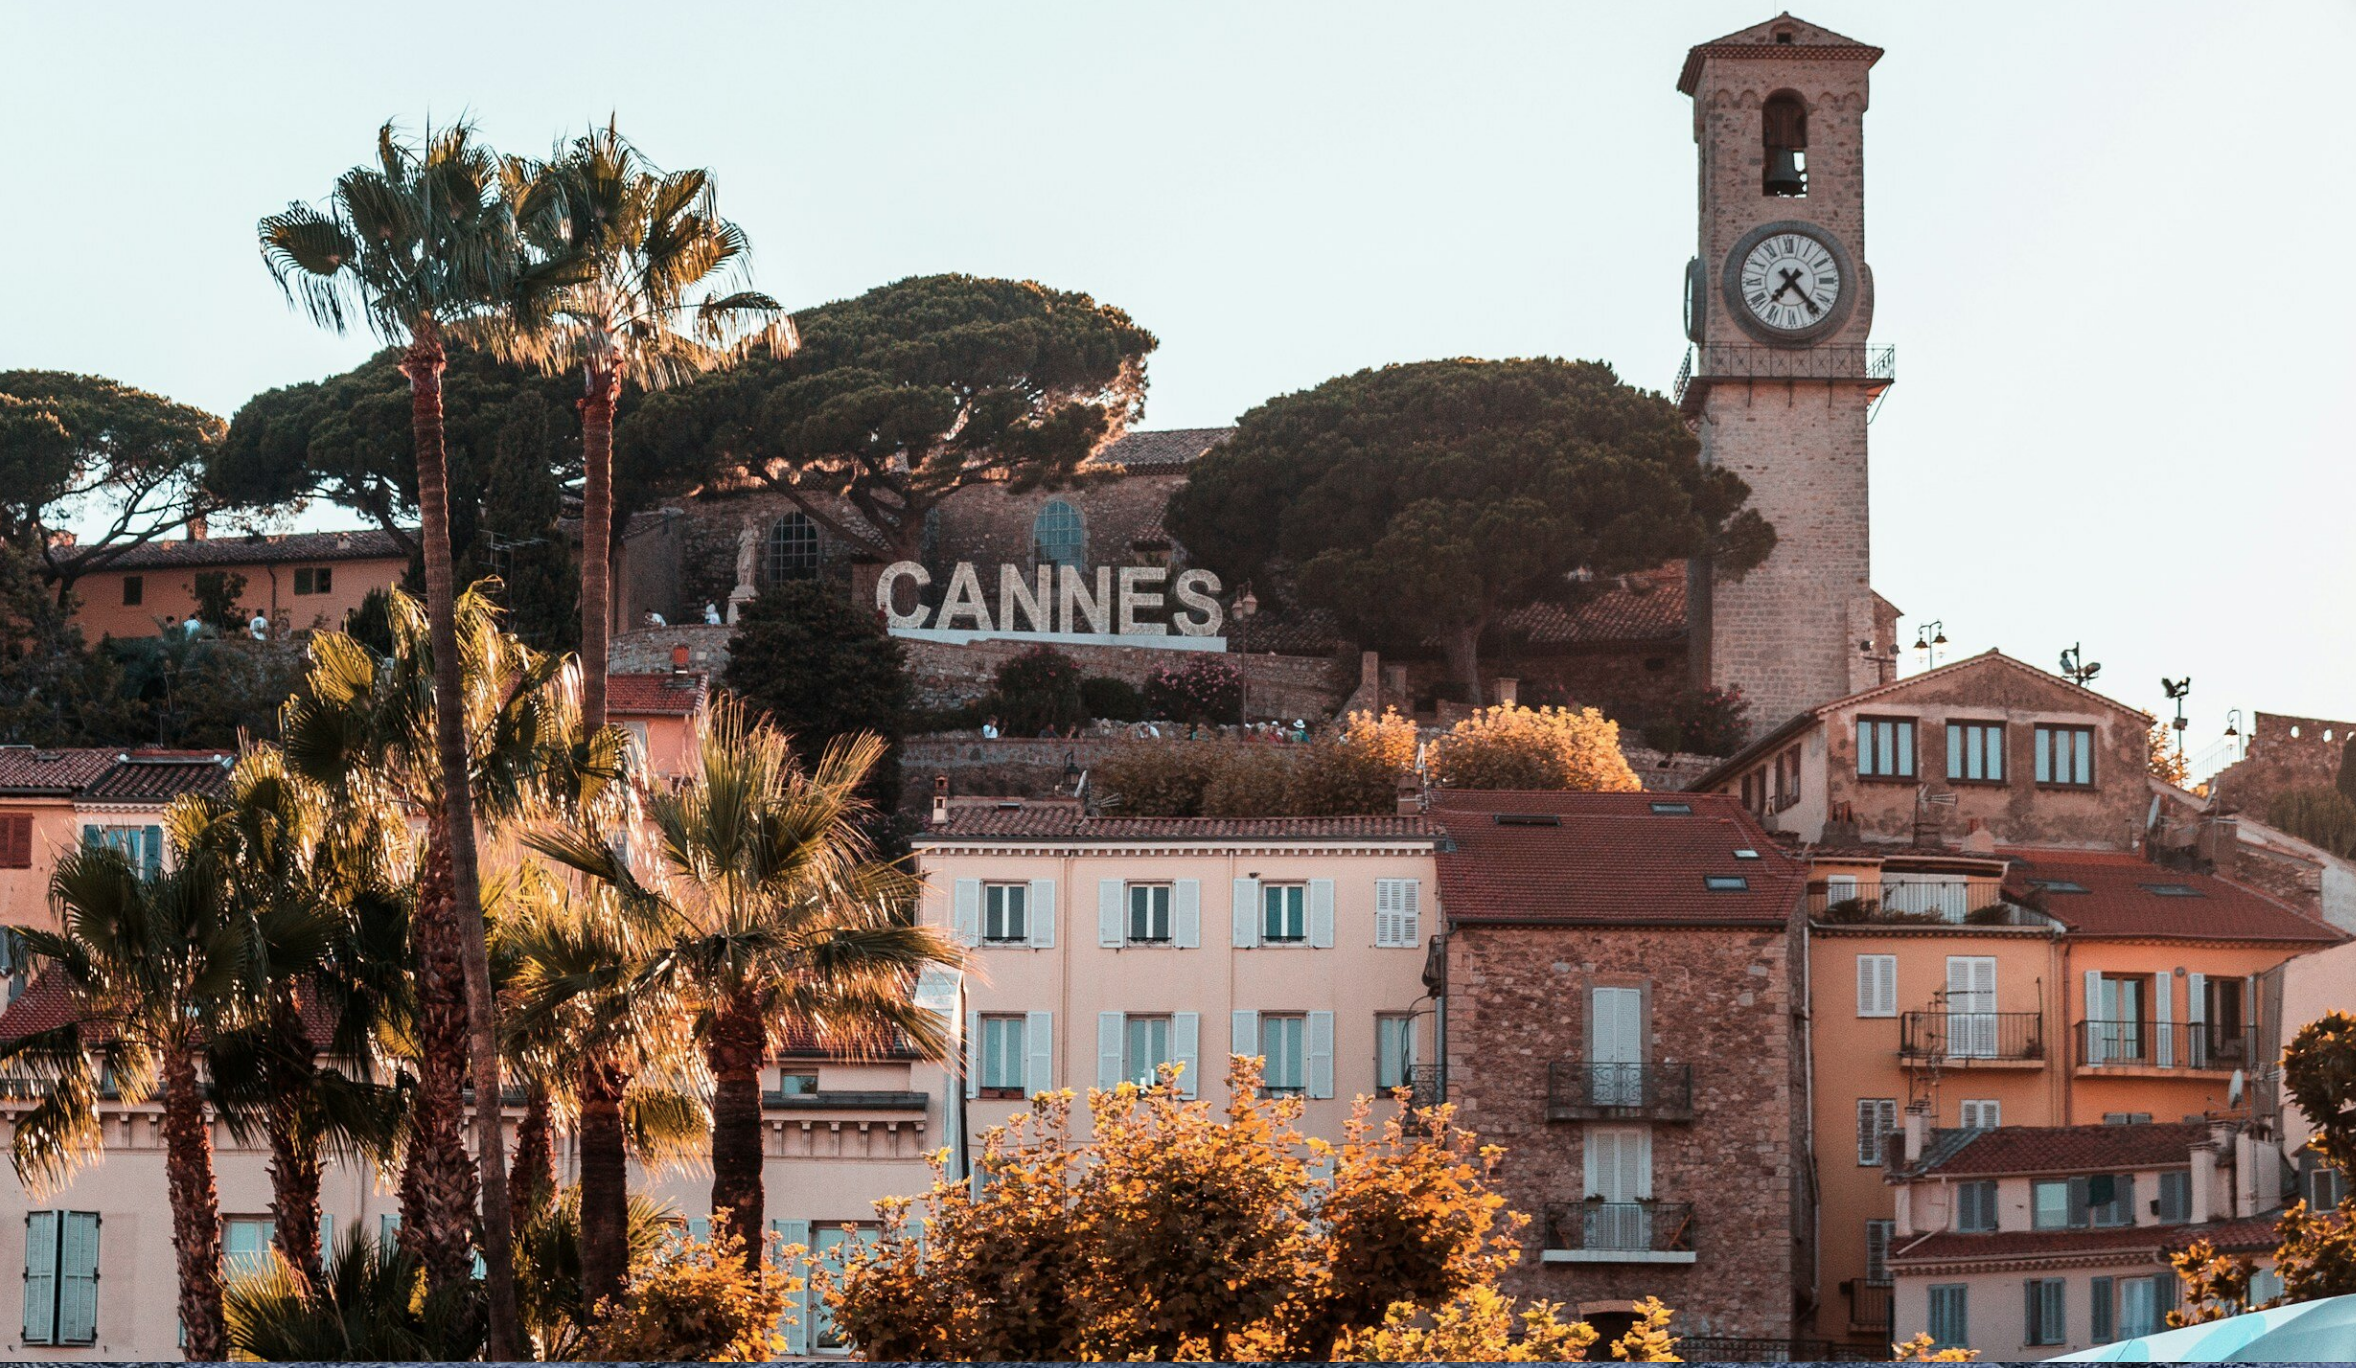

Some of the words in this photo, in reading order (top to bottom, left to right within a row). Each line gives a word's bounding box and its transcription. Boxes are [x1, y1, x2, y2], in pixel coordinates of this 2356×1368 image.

[1783, 238, 1794, 254] XII
[1802, 241, 1813, 257] I
[876, 561, 1223, 636] CANNES
